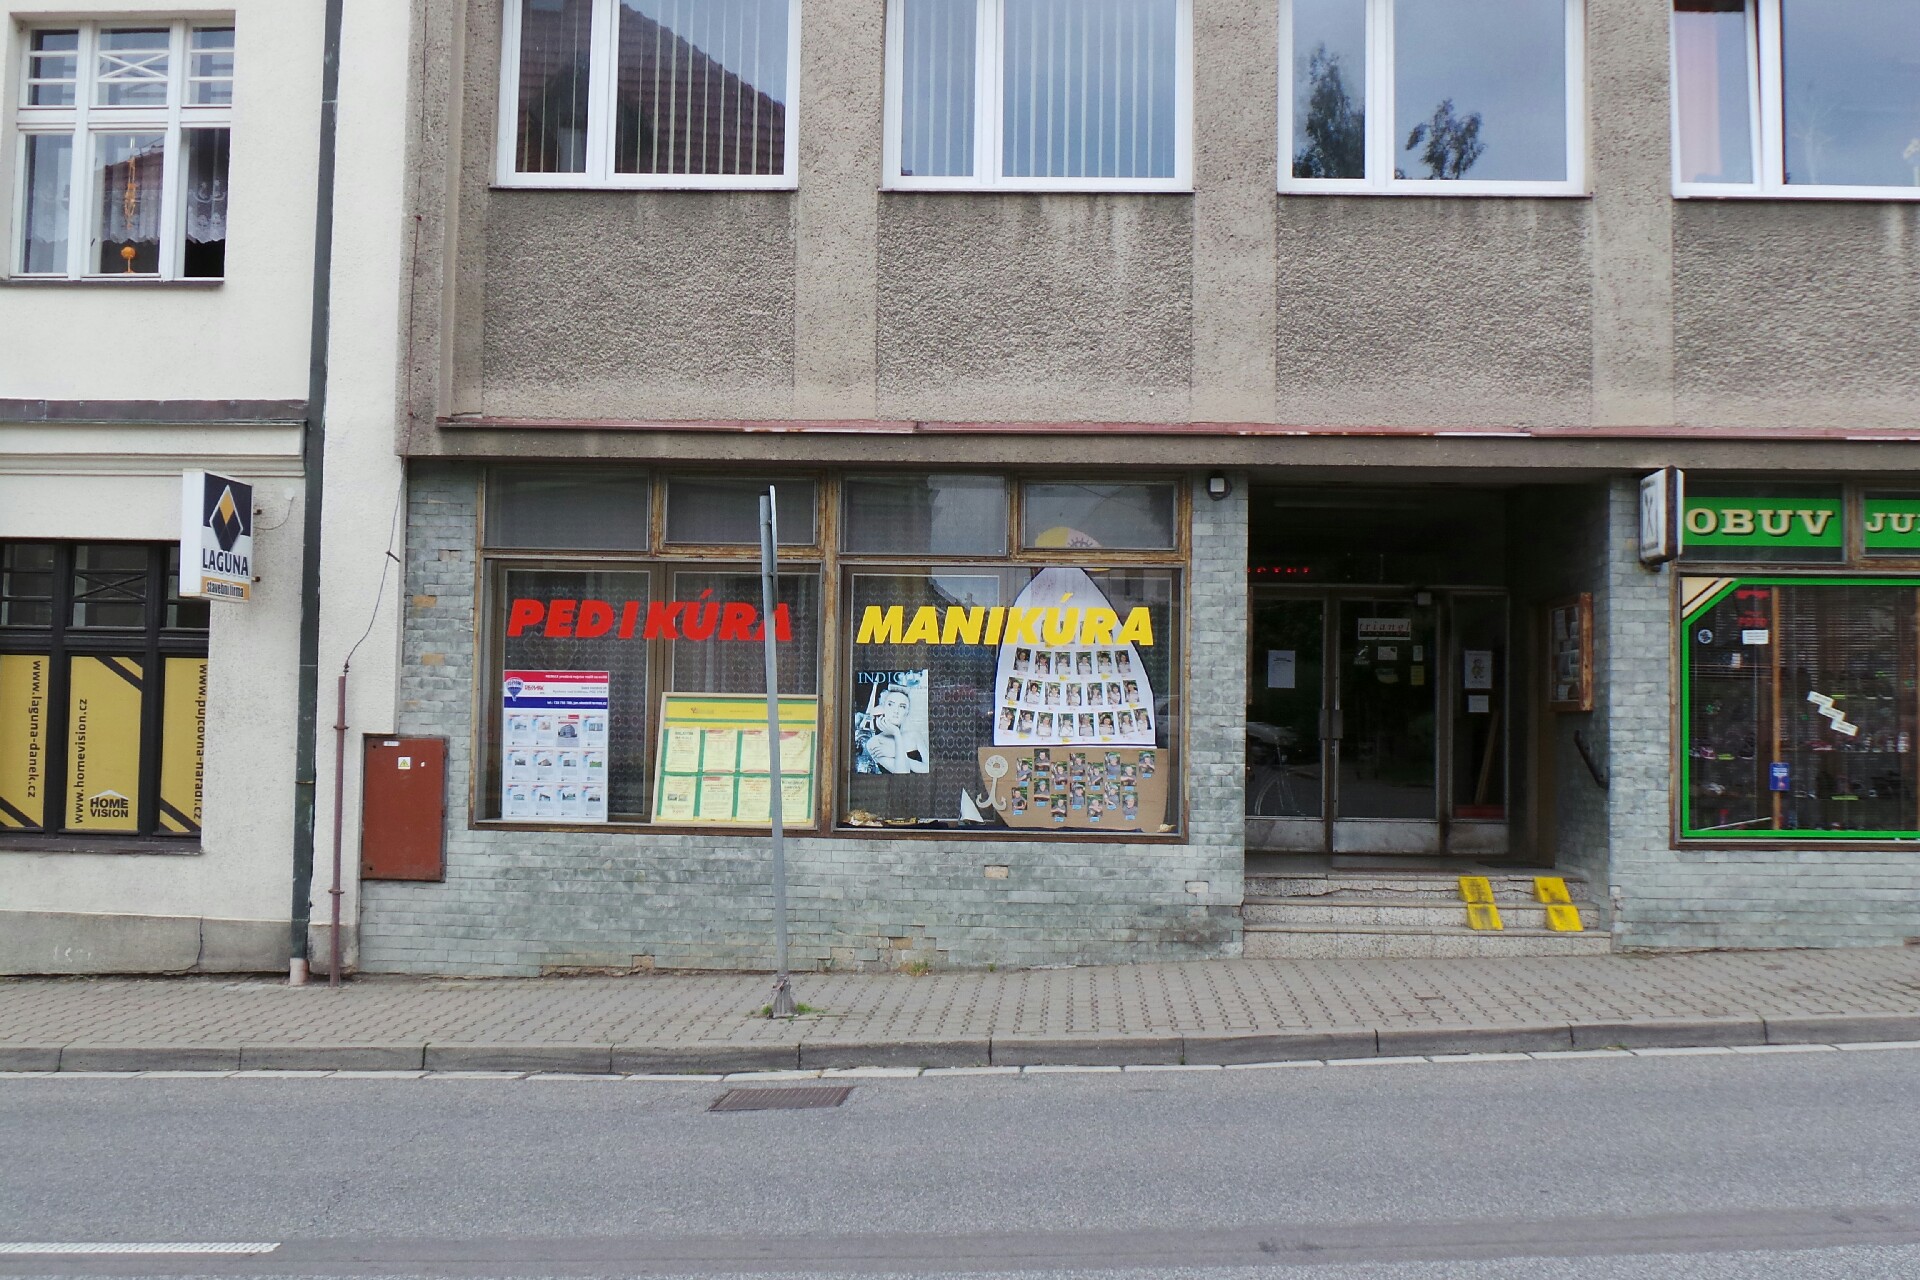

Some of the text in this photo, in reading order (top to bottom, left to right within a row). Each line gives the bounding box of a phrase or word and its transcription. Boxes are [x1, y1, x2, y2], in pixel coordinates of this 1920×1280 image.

[1686, 508, 1833, 536] OBUV
[1865, 512, 1920, 533] JU
[202, 547, 249, 577] LAGUNA
[506, 588, 793, 642] PEDIKÚRA
[856, 592, 1154, 646] MANIKÚRA
[27, 660, 42, 798] www.laguna-danek.cz
[73, 698, 88, 824] www.homevision.cz
[90, 797, 129, 808] HOME
[90, 809, 129, 818] VISION
